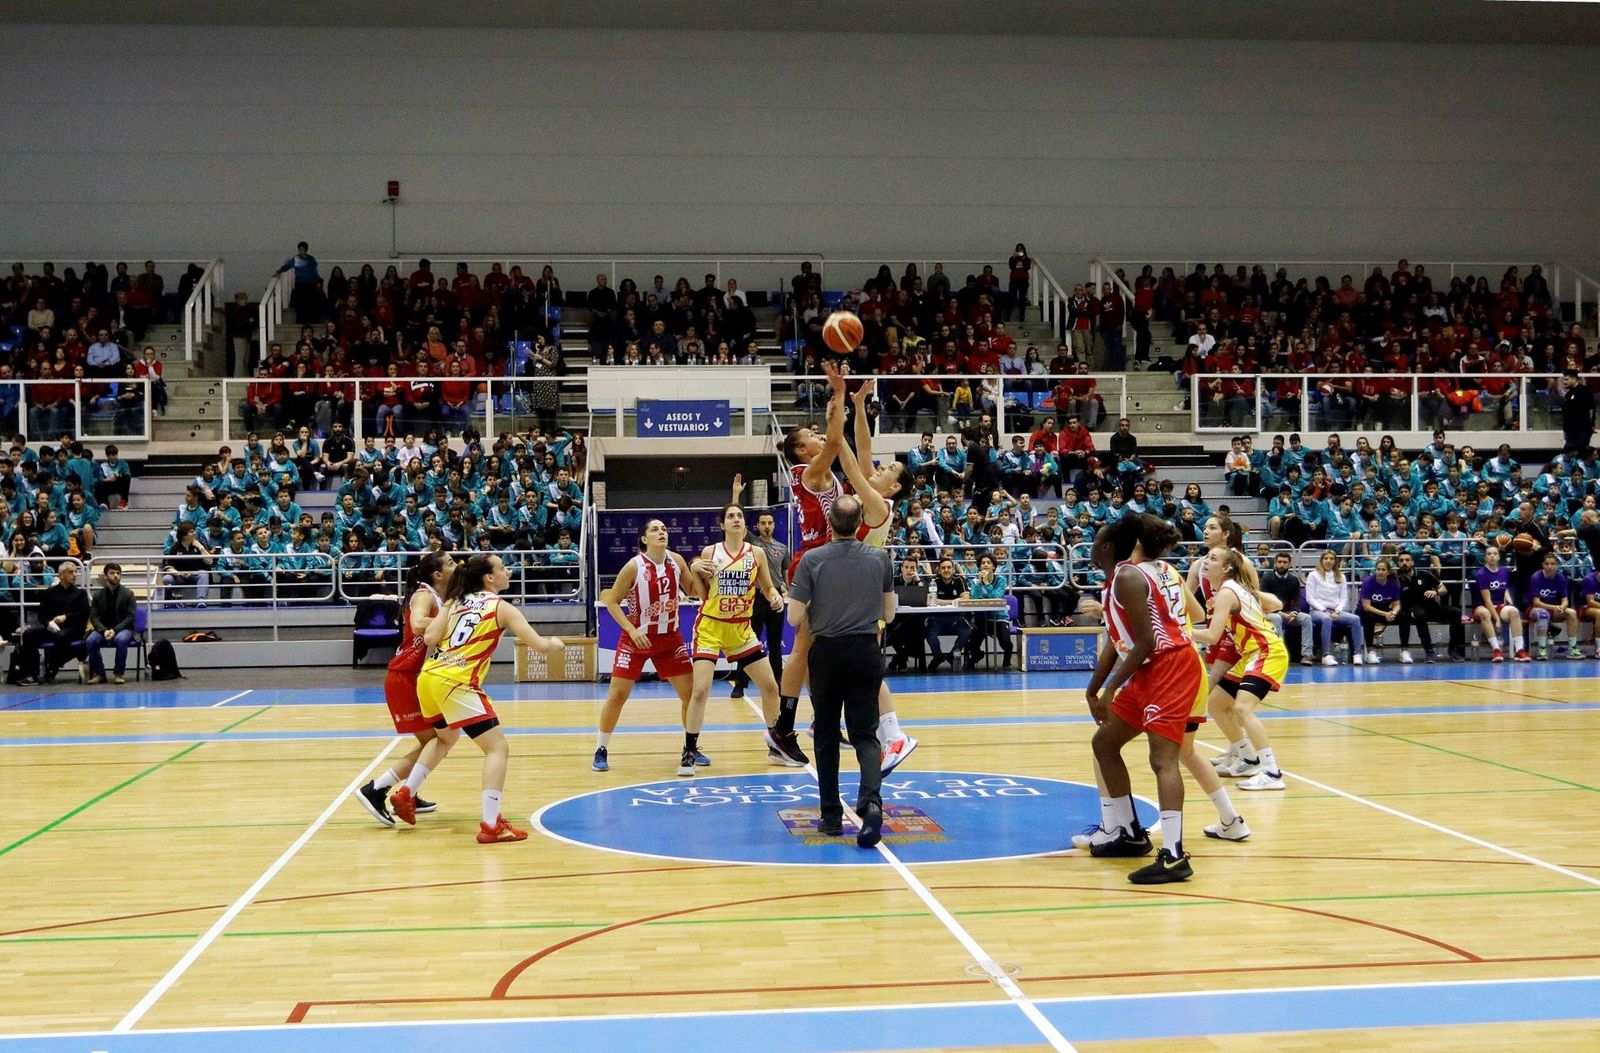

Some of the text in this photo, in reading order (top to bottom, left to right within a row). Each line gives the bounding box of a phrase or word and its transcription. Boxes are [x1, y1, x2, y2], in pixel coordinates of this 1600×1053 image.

[666, 413, 701, 421] ASEOS Y
[658, 423, 709, 431] VESTUARIOS
[718, 570, 752, 579] CITYLIFT
[656, 577, 671, 594] 12
[449, 611, 482, 648] 6
[936, 777, 1024, 788] DE
